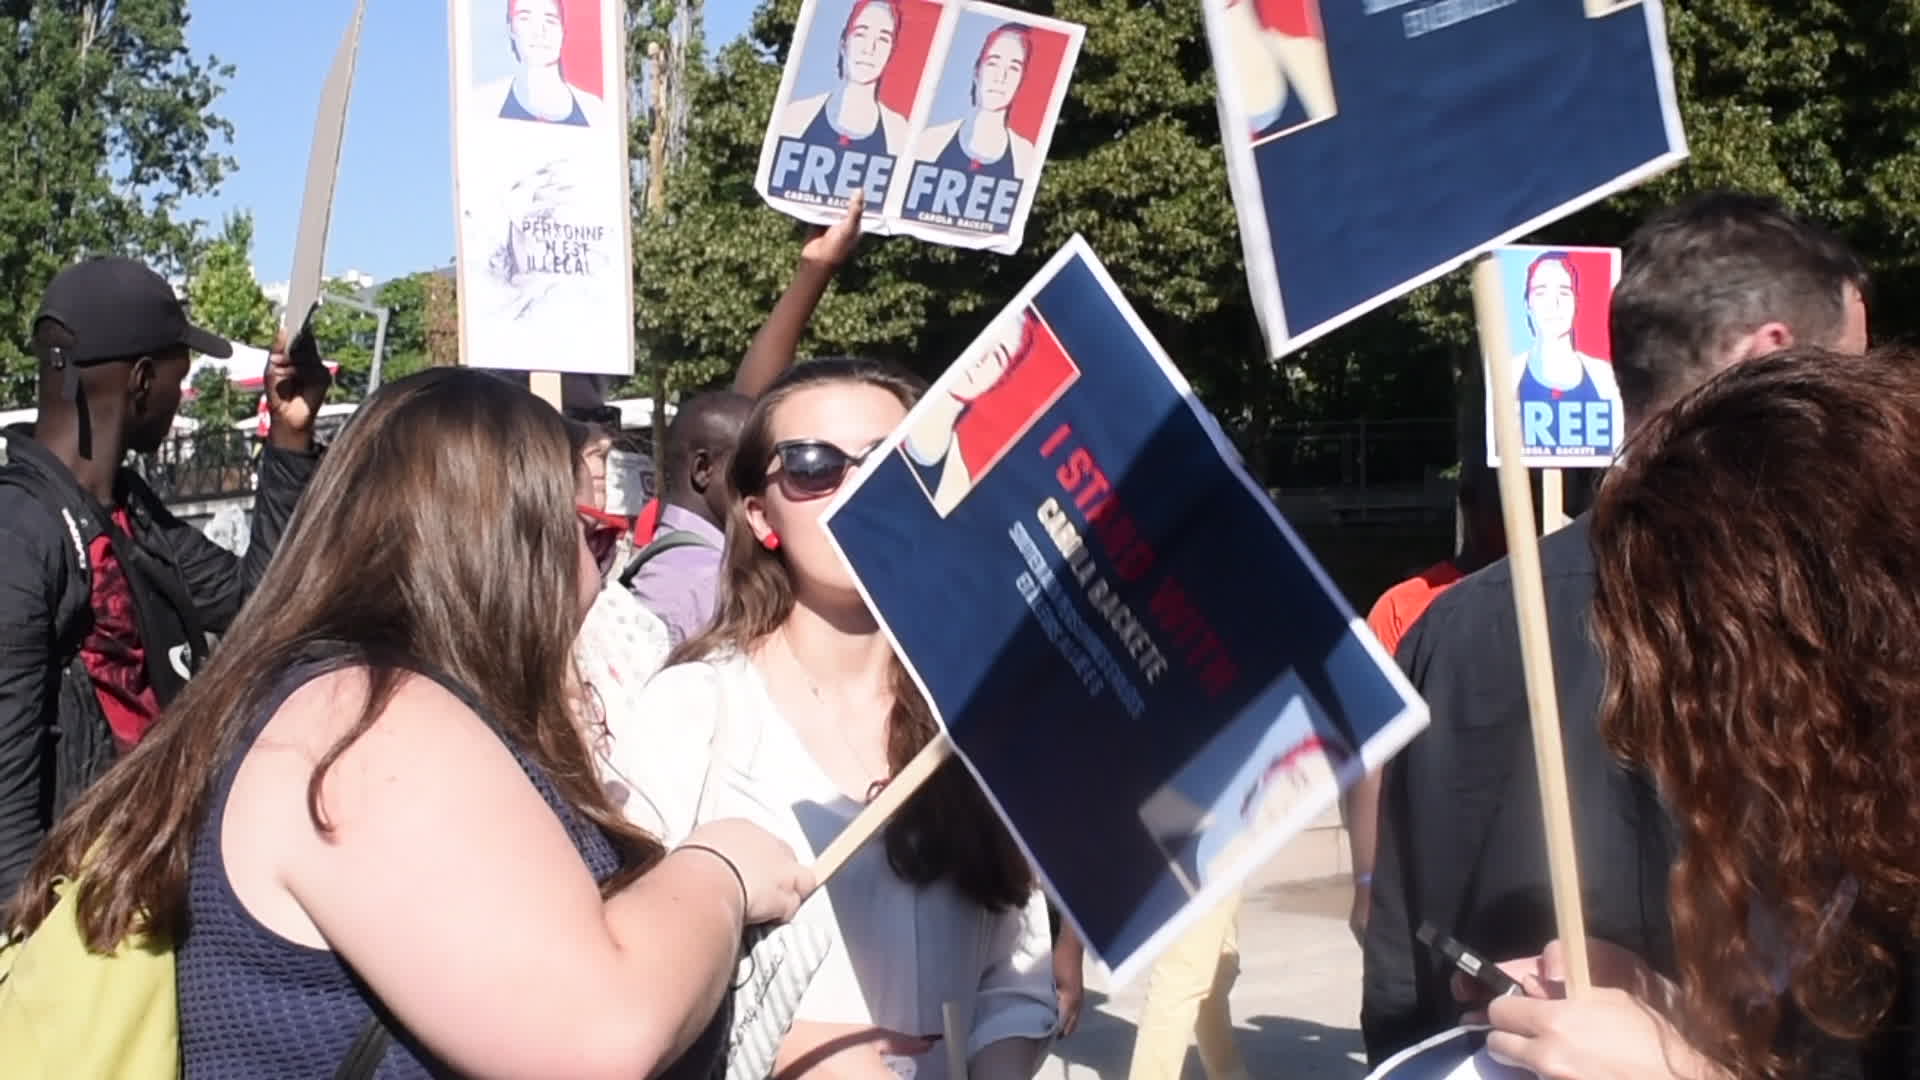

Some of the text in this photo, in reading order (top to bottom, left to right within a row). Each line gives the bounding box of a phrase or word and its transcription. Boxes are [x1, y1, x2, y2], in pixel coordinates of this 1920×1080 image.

[772, 140, 894, 202] FREE
[906, 165, 1020, 225] FREE
[1040, 423, 1072, 458] I
[1523, 401, 1610, 446] REE
